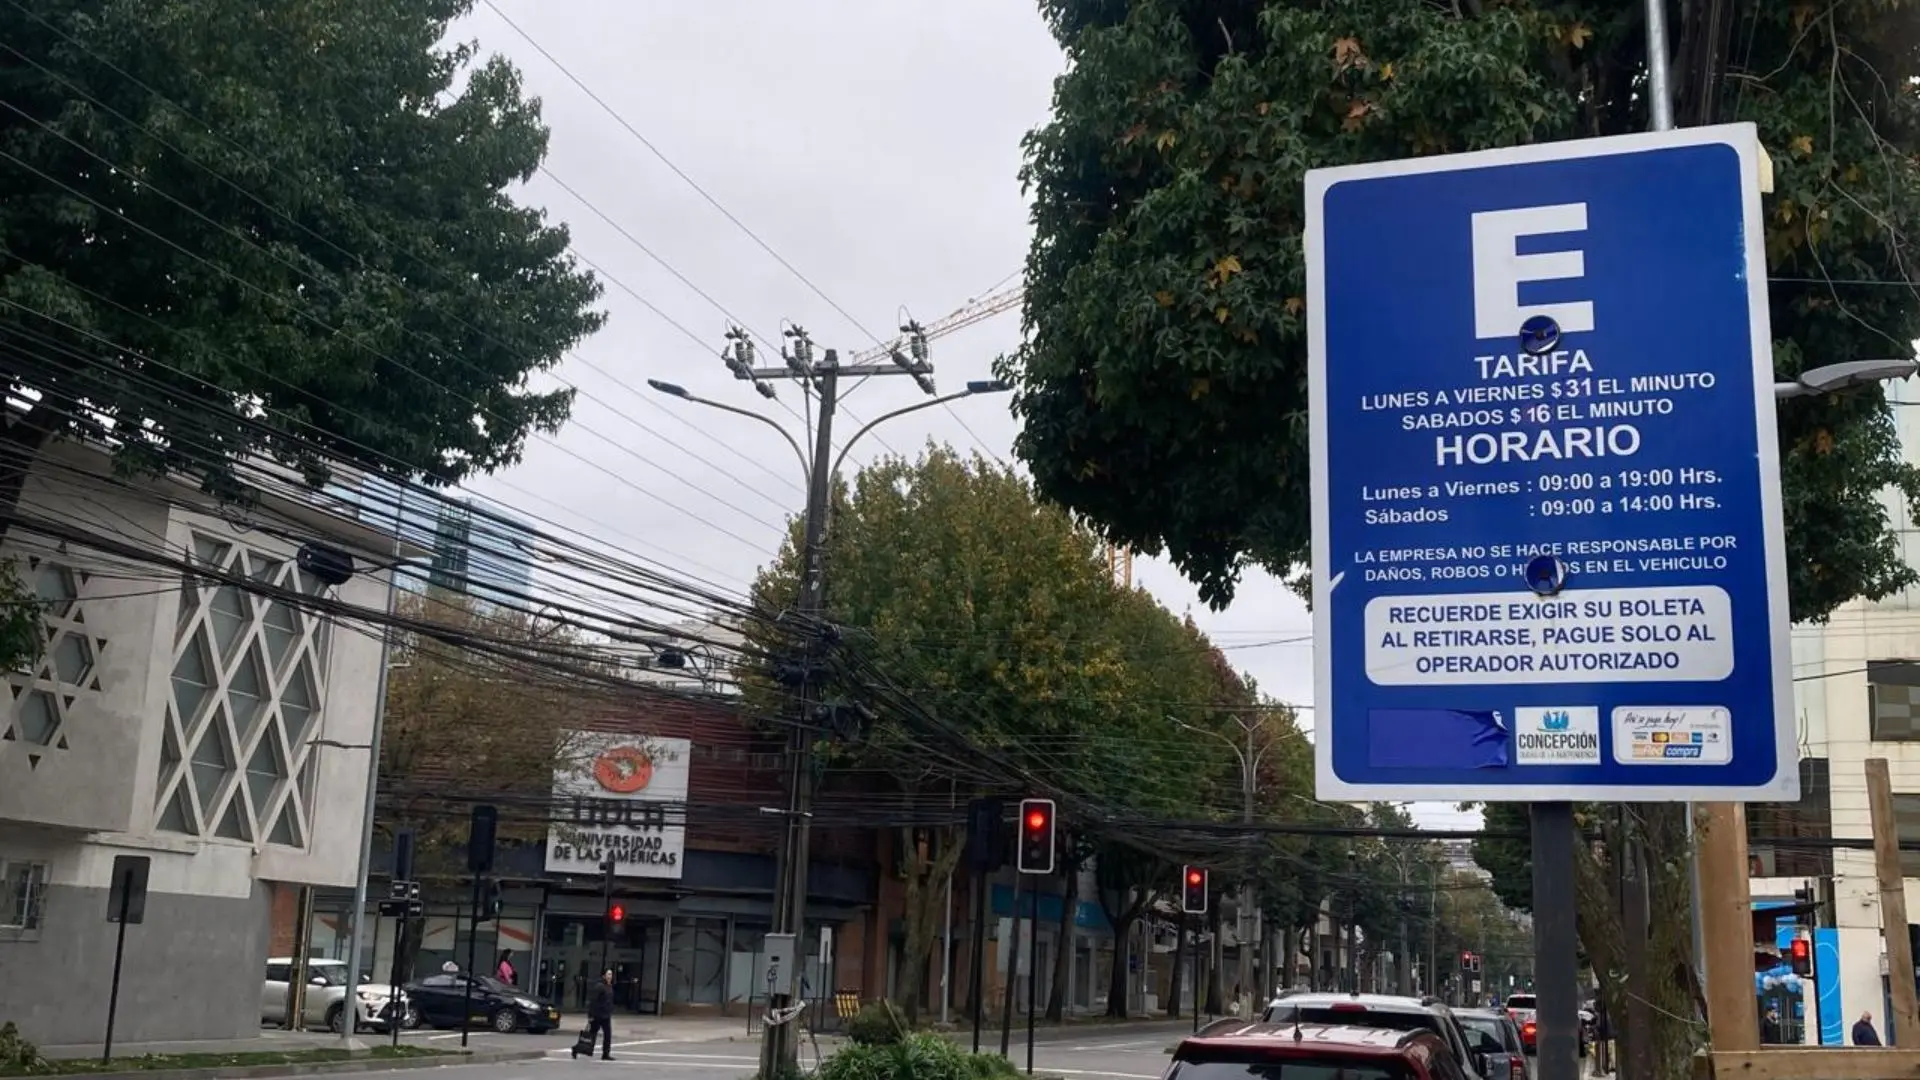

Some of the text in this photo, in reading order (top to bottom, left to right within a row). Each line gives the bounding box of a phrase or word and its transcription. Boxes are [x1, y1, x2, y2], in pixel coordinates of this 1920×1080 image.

[1472, 203, 1594, 339] E
[1474, 350, 1593, 379] TARIFA
[1361, 391, 1429, 410] LUNES
[1434, 391, 1449, 405] A
[1454, 384, 1544, 403] VIERNES
[1598, 379, 1625, 394] EL
[1631, 372, 1715, 393] MINUTO
[1402, 410, 1504, 430] SABADOS
[1557, 405, 1584, 420] EL
[1590, 399, 1673, 418] MINUTO
[1436, 424, 1640, 466] HORARIO
[1363, 484, 1422, 500] Lunes
[1428, 486, 1439, 498] a
[1445, 480, 1521, 497] Viernes
[1539, 473, 1593, 491] 09:00
[1600, 475, 1612, 488] a
[1618, 469, 1673, 487] 19:00
[1680, 468, 1723, 485] Hrs.
[1365, 507, 1449, 525] Sábados
[1541, 498, 1595, 516] 09:00
[1601, 500, 1613, 513] a
[1619, 495, 1673, 512] 14:00
[1680, 494, 1722, 510] Hrs.
[1355, 535, 1737, 563] LA EMPRESA NO SE HACE RESPONSABLE POR
[1365, 566, 1426, 582] DAÑOS,
[1431, 564, 1490, 579] ROBOS
[1494, 564, 1507, 577] O
[1586, 560, 1609, 574] EN
[1613, 559, 1635, 572] EL
[1639, 556, 1727, 571] VEHICULO
[1389, 598, 1705, 623] RECUERDE EXIGIR SU BOLETA
[1381, 624, 1715, 648] AL RETIRARSE, PAGUE SOLO AL
[1416, 652, 1680, 673] OPERADOR AUTORIZADO
[1518, 730, 1597, 749] CONCEPCIÓN
[553, 845, 571, 860] DE
[577, 847, 602, 861] LAS
